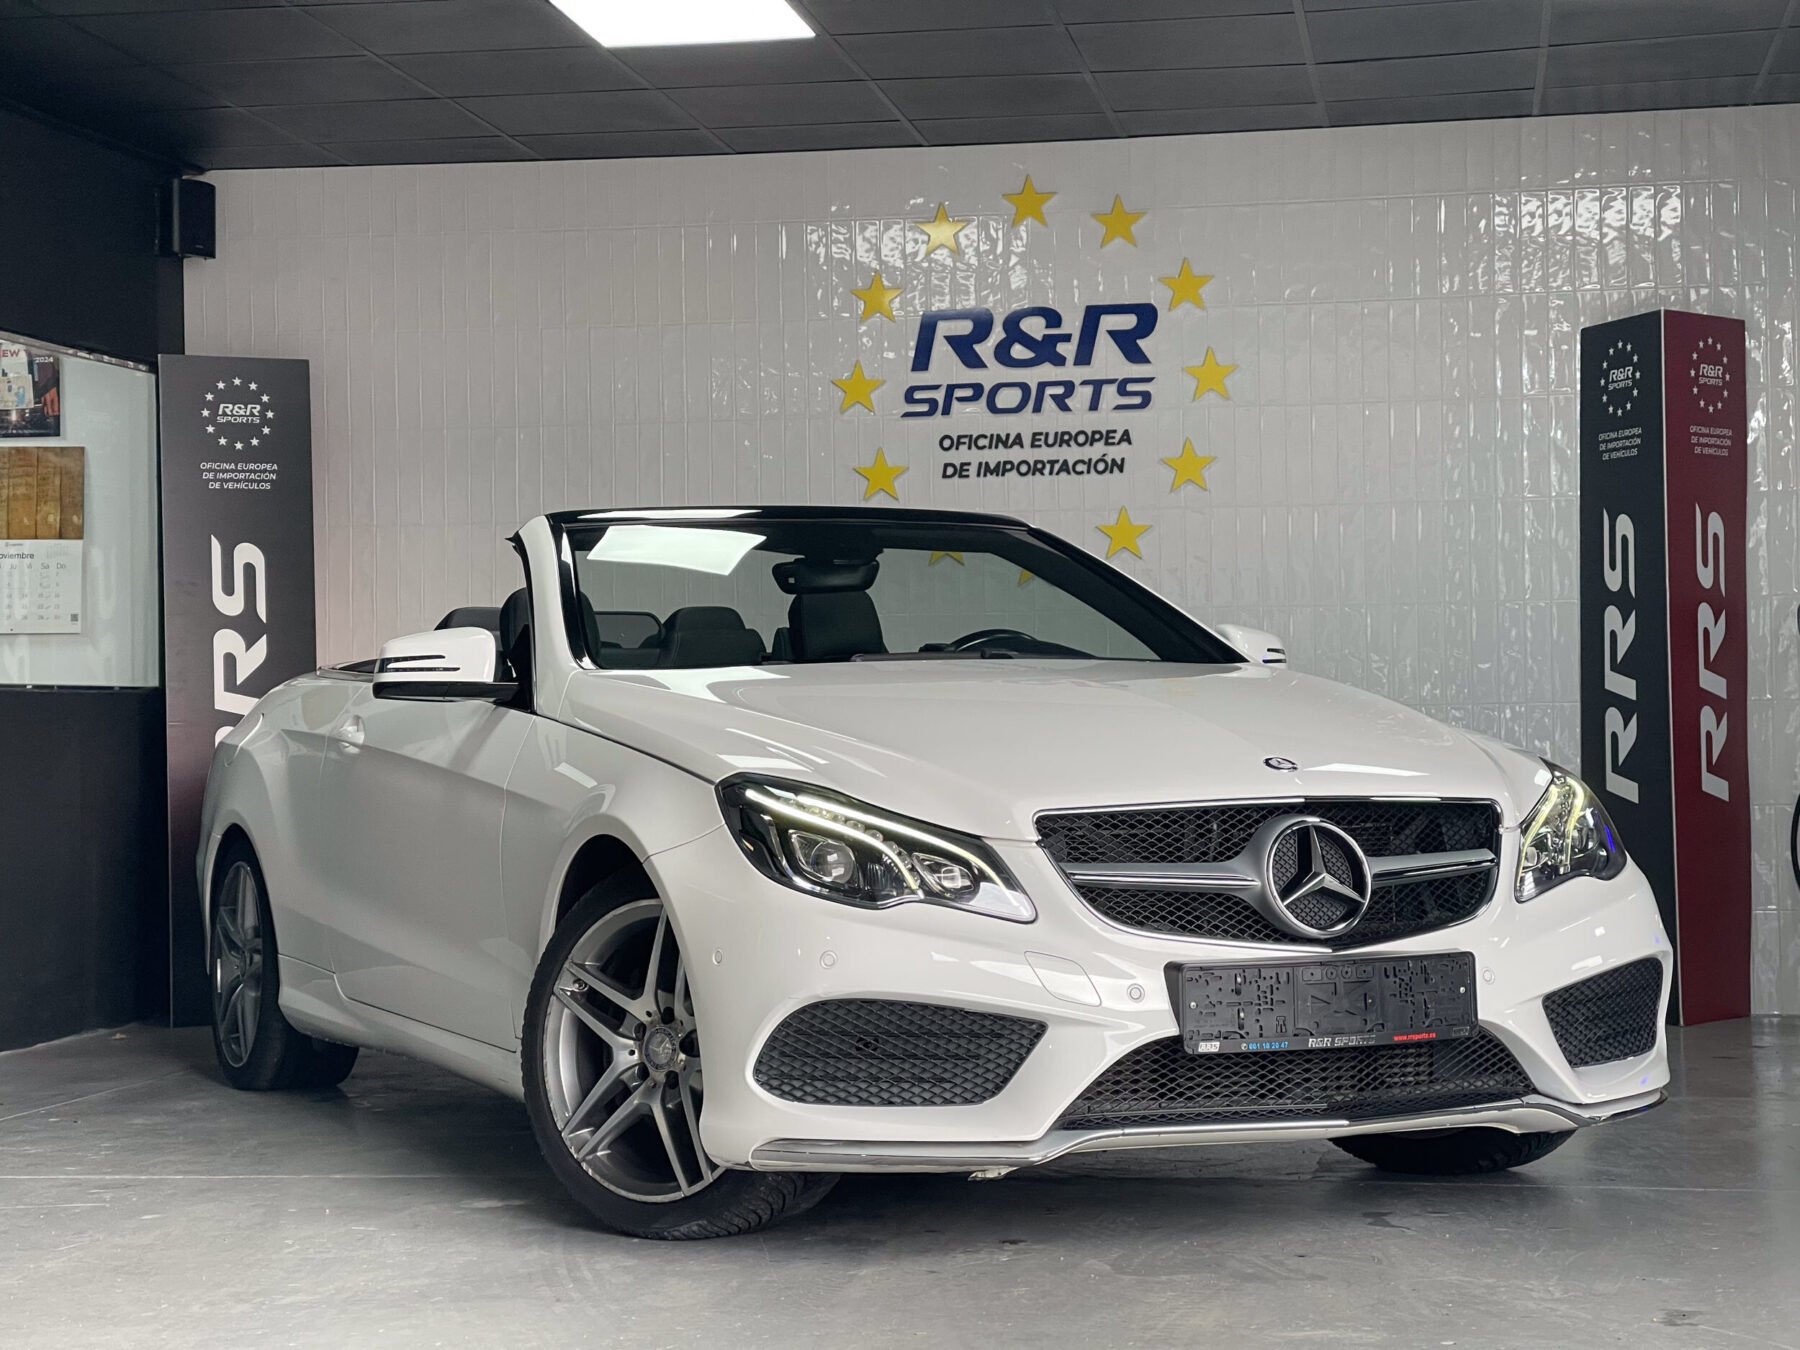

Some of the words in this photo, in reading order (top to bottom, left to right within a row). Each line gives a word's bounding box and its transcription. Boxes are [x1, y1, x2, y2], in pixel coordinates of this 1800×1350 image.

[911, 303, 1158, 372] R&R
[0, 349, 20, 358] EW
[1609, 366, 1633, 382] R&R
[1699, 364, 1723, 378] R&R
[1608, 379, 1633, 391] SPORTS
[1699, 377, 1723, 386] SPORTS
[901, 377, 1156, 418] SPORTS
[218, 403, 261, 416] R&R
[216, 416, 260, 424] SPORTS
[938, 432, 1024, 451] OFICINA
[1030, 429, 1132, 449] EUROPEA
[200, 462, 236, 470] OFICINA
[237, 463, 278, 471] EUROPEA
[941, 462, 972, 479] DE
[977, 453, 1125, 478] IMPORTACIÓN
[216, 472, 277, 480] IMPORTACIÓN
[223, 481, 271, 490] VEHÍCULOS
[0, 552, 35, 560] oviembre
[211, 534, 267, 748] RS
[1308, 1037, 1332, 1048] R&R
